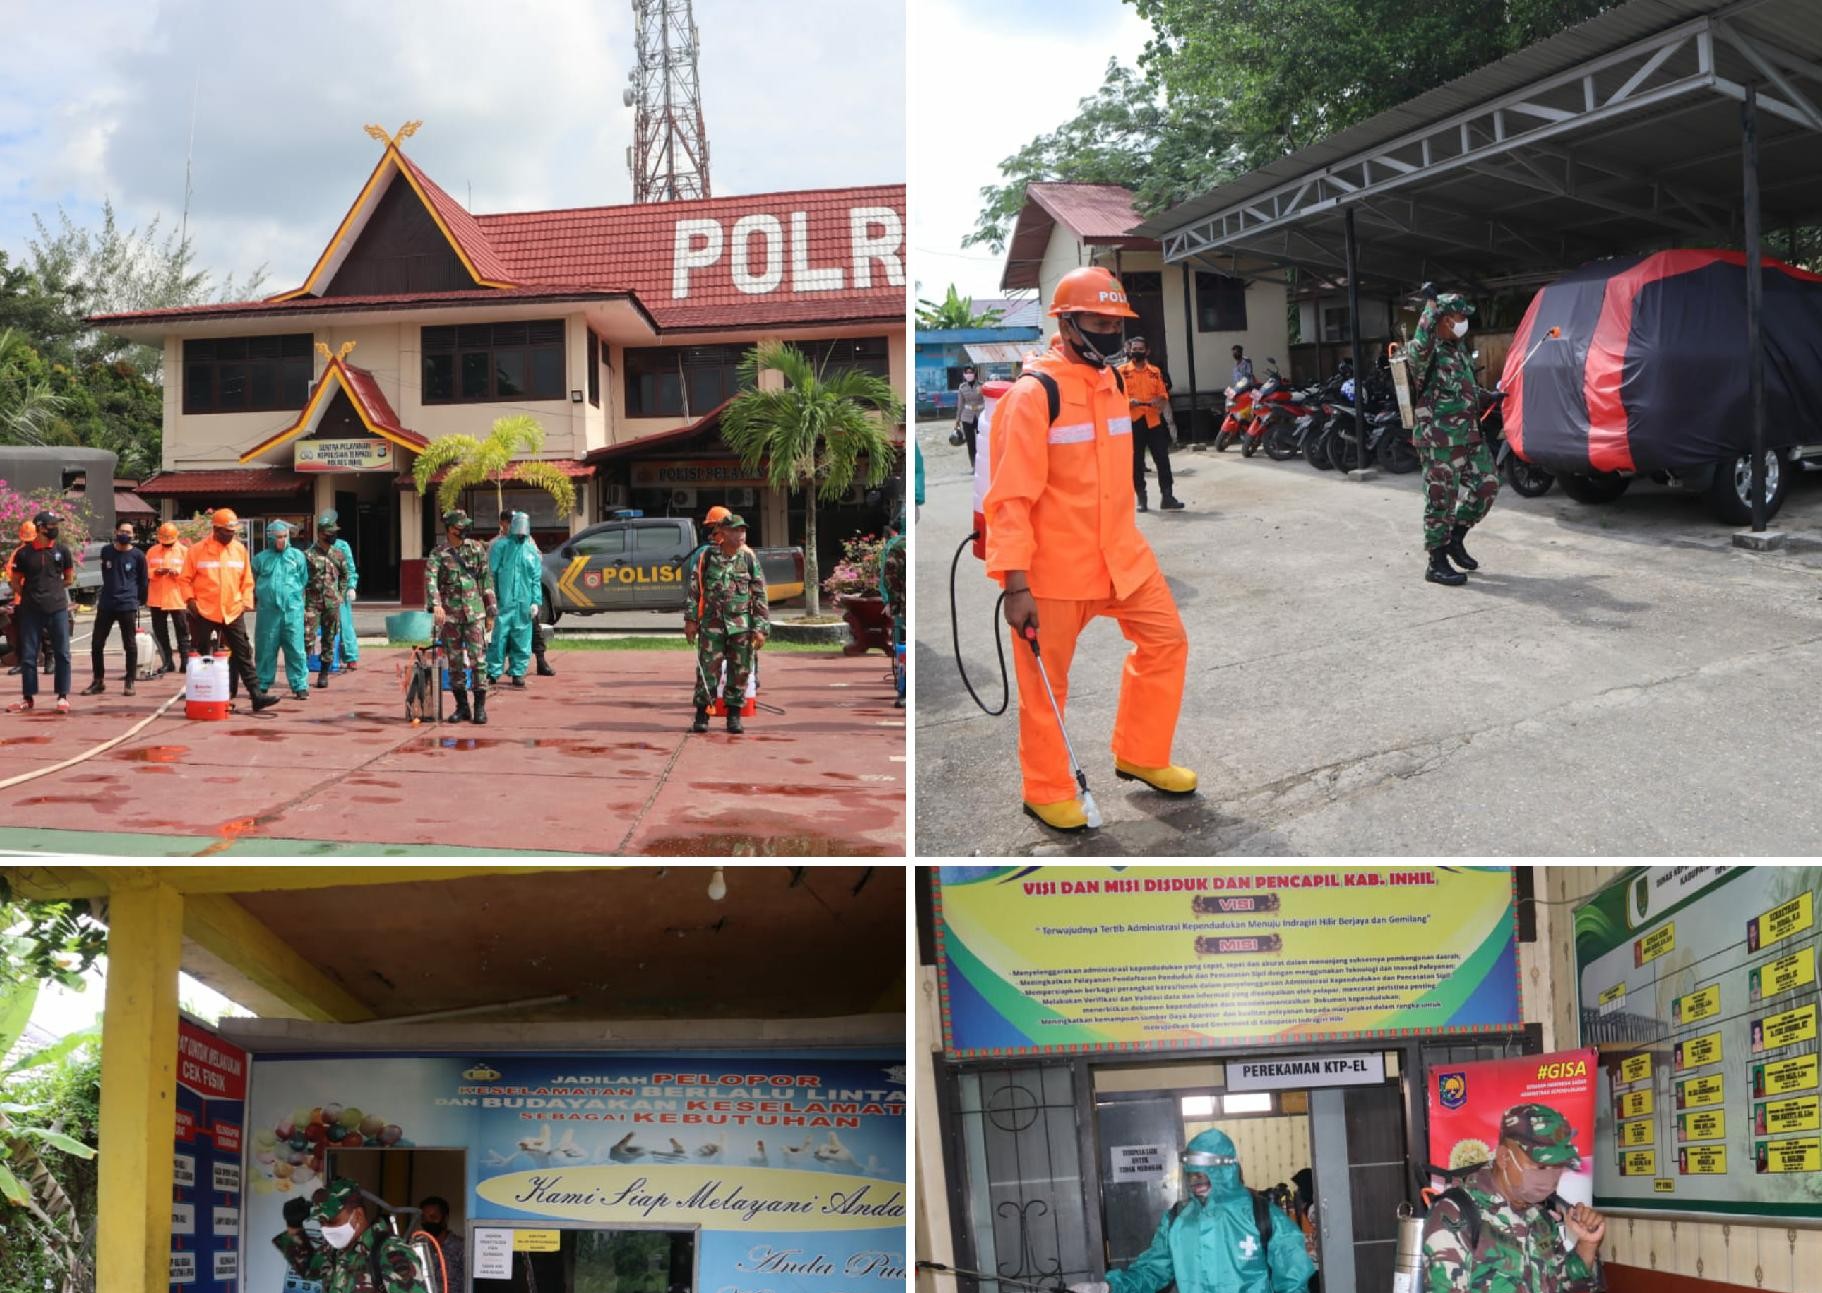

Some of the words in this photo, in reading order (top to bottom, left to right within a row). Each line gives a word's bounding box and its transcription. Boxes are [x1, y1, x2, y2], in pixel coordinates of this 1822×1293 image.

[603, 566, 682, 584] POLISI
[1023, 882, 1056, 896] VISI
[1061, 881, 1100, 894] DAN
[1104, 879, 1140, 893] MISI
[1144, 878, 1208, 892] DISDUK
[1213, 876, 1249, 890] DAN
[1255, 874, 1340, 889] PENCAPIL
[1344, 873, 1386, 887] KAB.
[1219, 898, 1254, 911] VISI
[1100, 924, 1125, 934] Tertib
[1127, 922, 1180, 933] Administrasi
[1182, 920, 1246, 932] Kependudukan
[1248, 919, 1281, 929] Menuju
[1283, 918, 1317, 928] Indragiri
[1338, 916, 1369, 927] Berjaya
[1372, 916, 1387, 924] dan
[182, 1061, 201, 1082] CEK
[203, 1068, 226, 1092] FISIK
[1243, 1061, 1320, 1077] PEREKAMAN
[1324, 1059, 1368, 1073] KTP-EL
[1538, 1060, 1586, 1080] #GISA
[551, 1075, 647, 1085] JADILAH
[652, 1073, 821, 1087] PELOPOR
[458, 1086, 635, 1096] KESELAMATAN
[641, 1087, 795, 1099] BERLALU
[482, 1097, 677, 1109] BUDAYAKAN
[520, 1112, 626, 1121] SEBAGAI
[633, 1112, 860, 1128] KEBUTUHAN
[514, 1175, 595, 1205] Kami
[600, 1178, 670, 1217] Siap
[675, 1181, 817, 1222] Melayani
[821, 1184, 906, 1218] Anda
[736, 1245, 834, 1277] Anda
